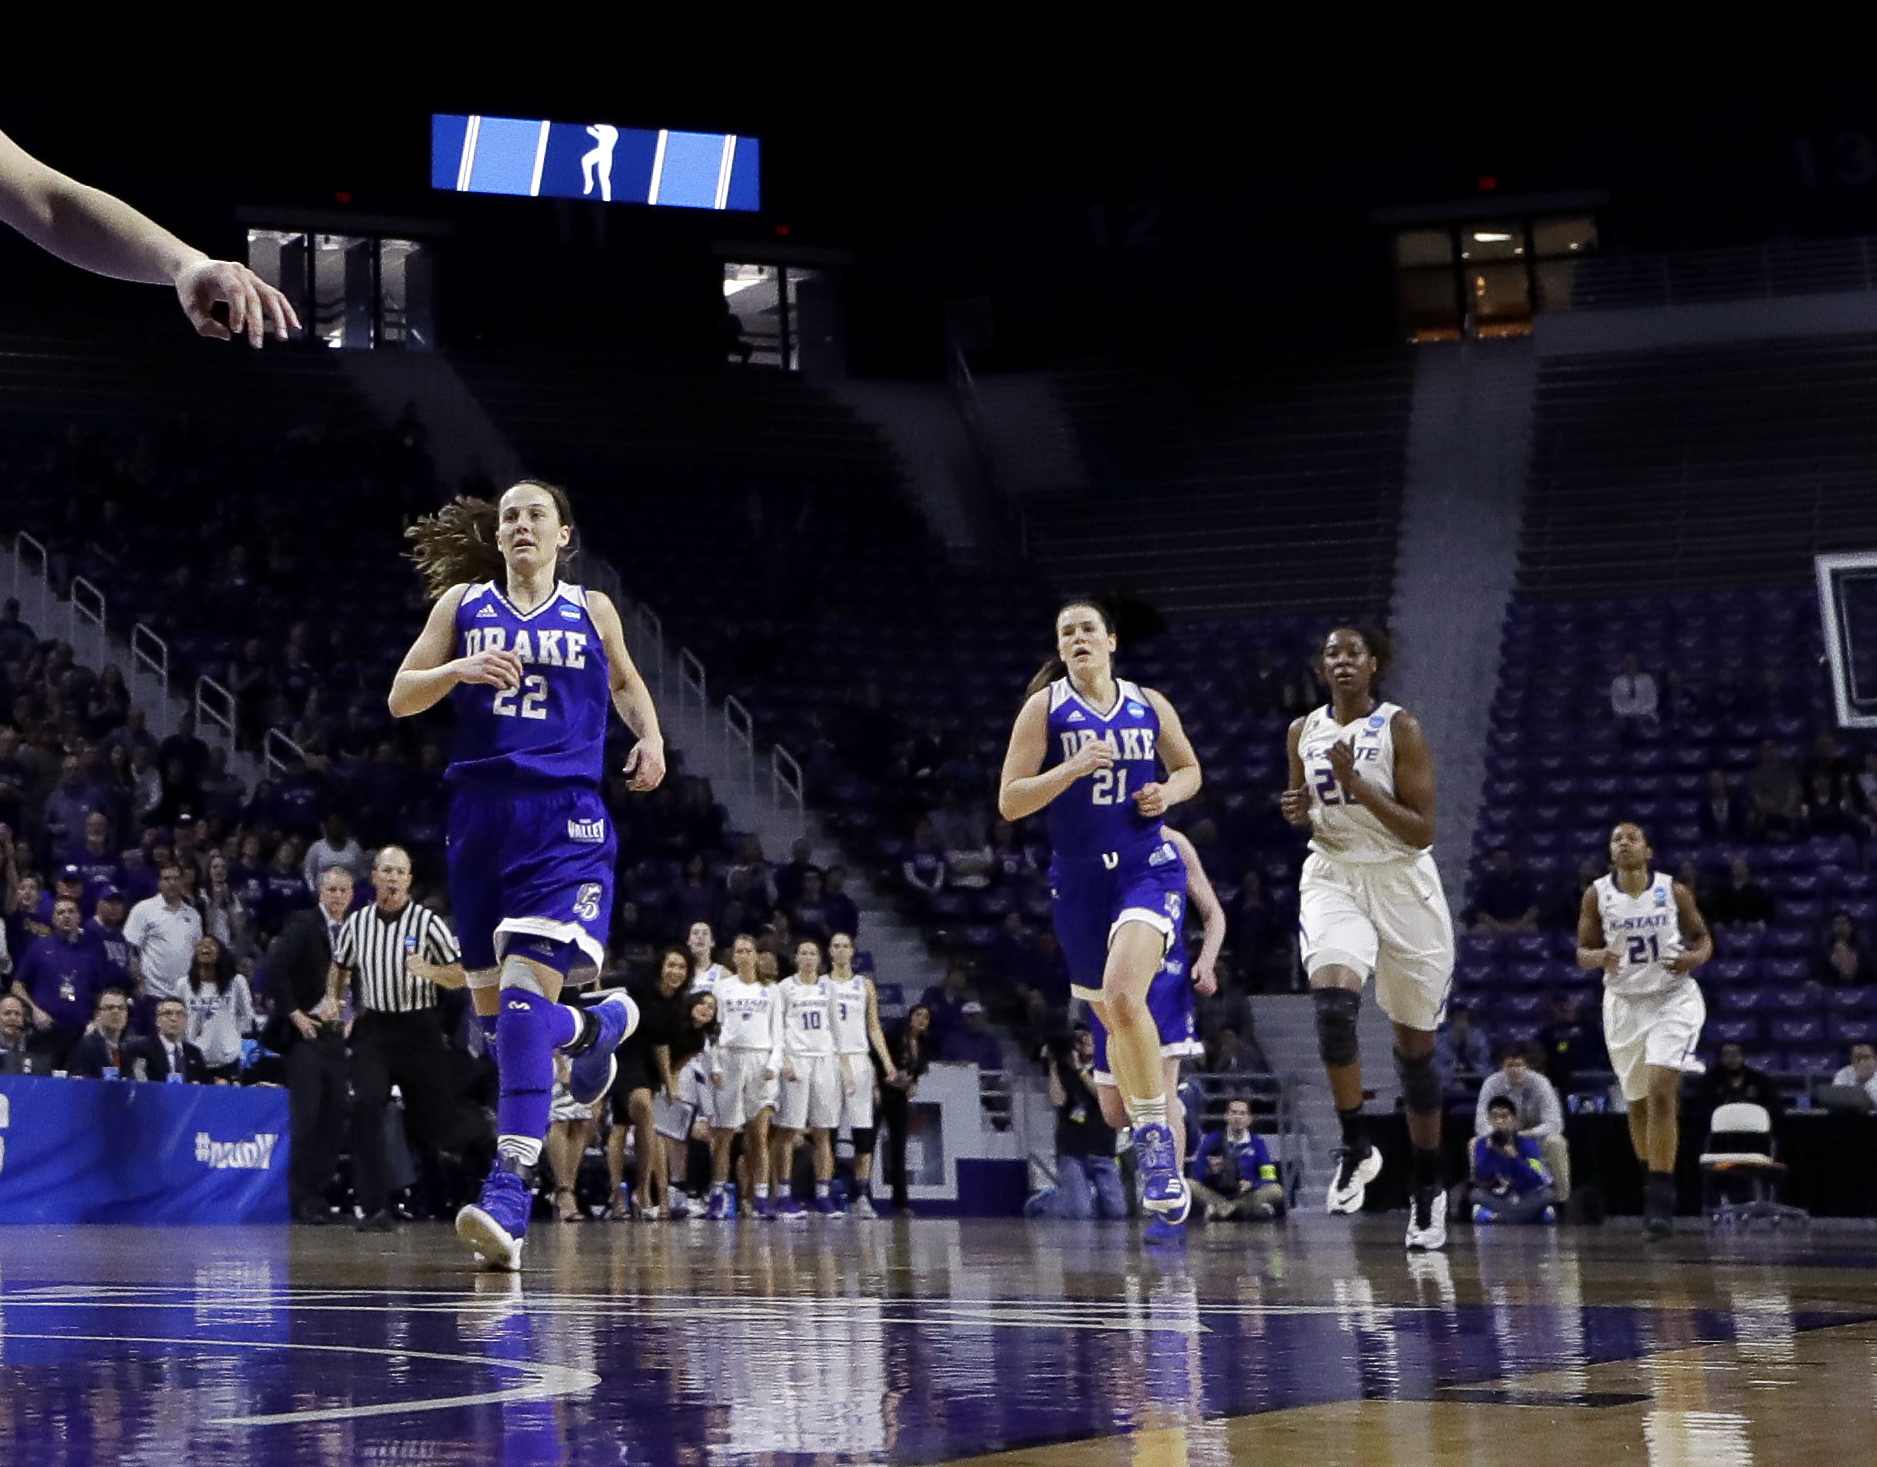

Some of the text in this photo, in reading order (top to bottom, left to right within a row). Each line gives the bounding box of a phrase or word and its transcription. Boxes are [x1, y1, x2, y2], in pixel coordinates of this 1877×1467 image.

[493, 674, 548, 720] 22
[1092, 768, 1128, 806] 21
[1314, 768, 1363, 805] 2
[1626, 935, 1659, 963] 21
[800, 1011, 821, 1031] 10
